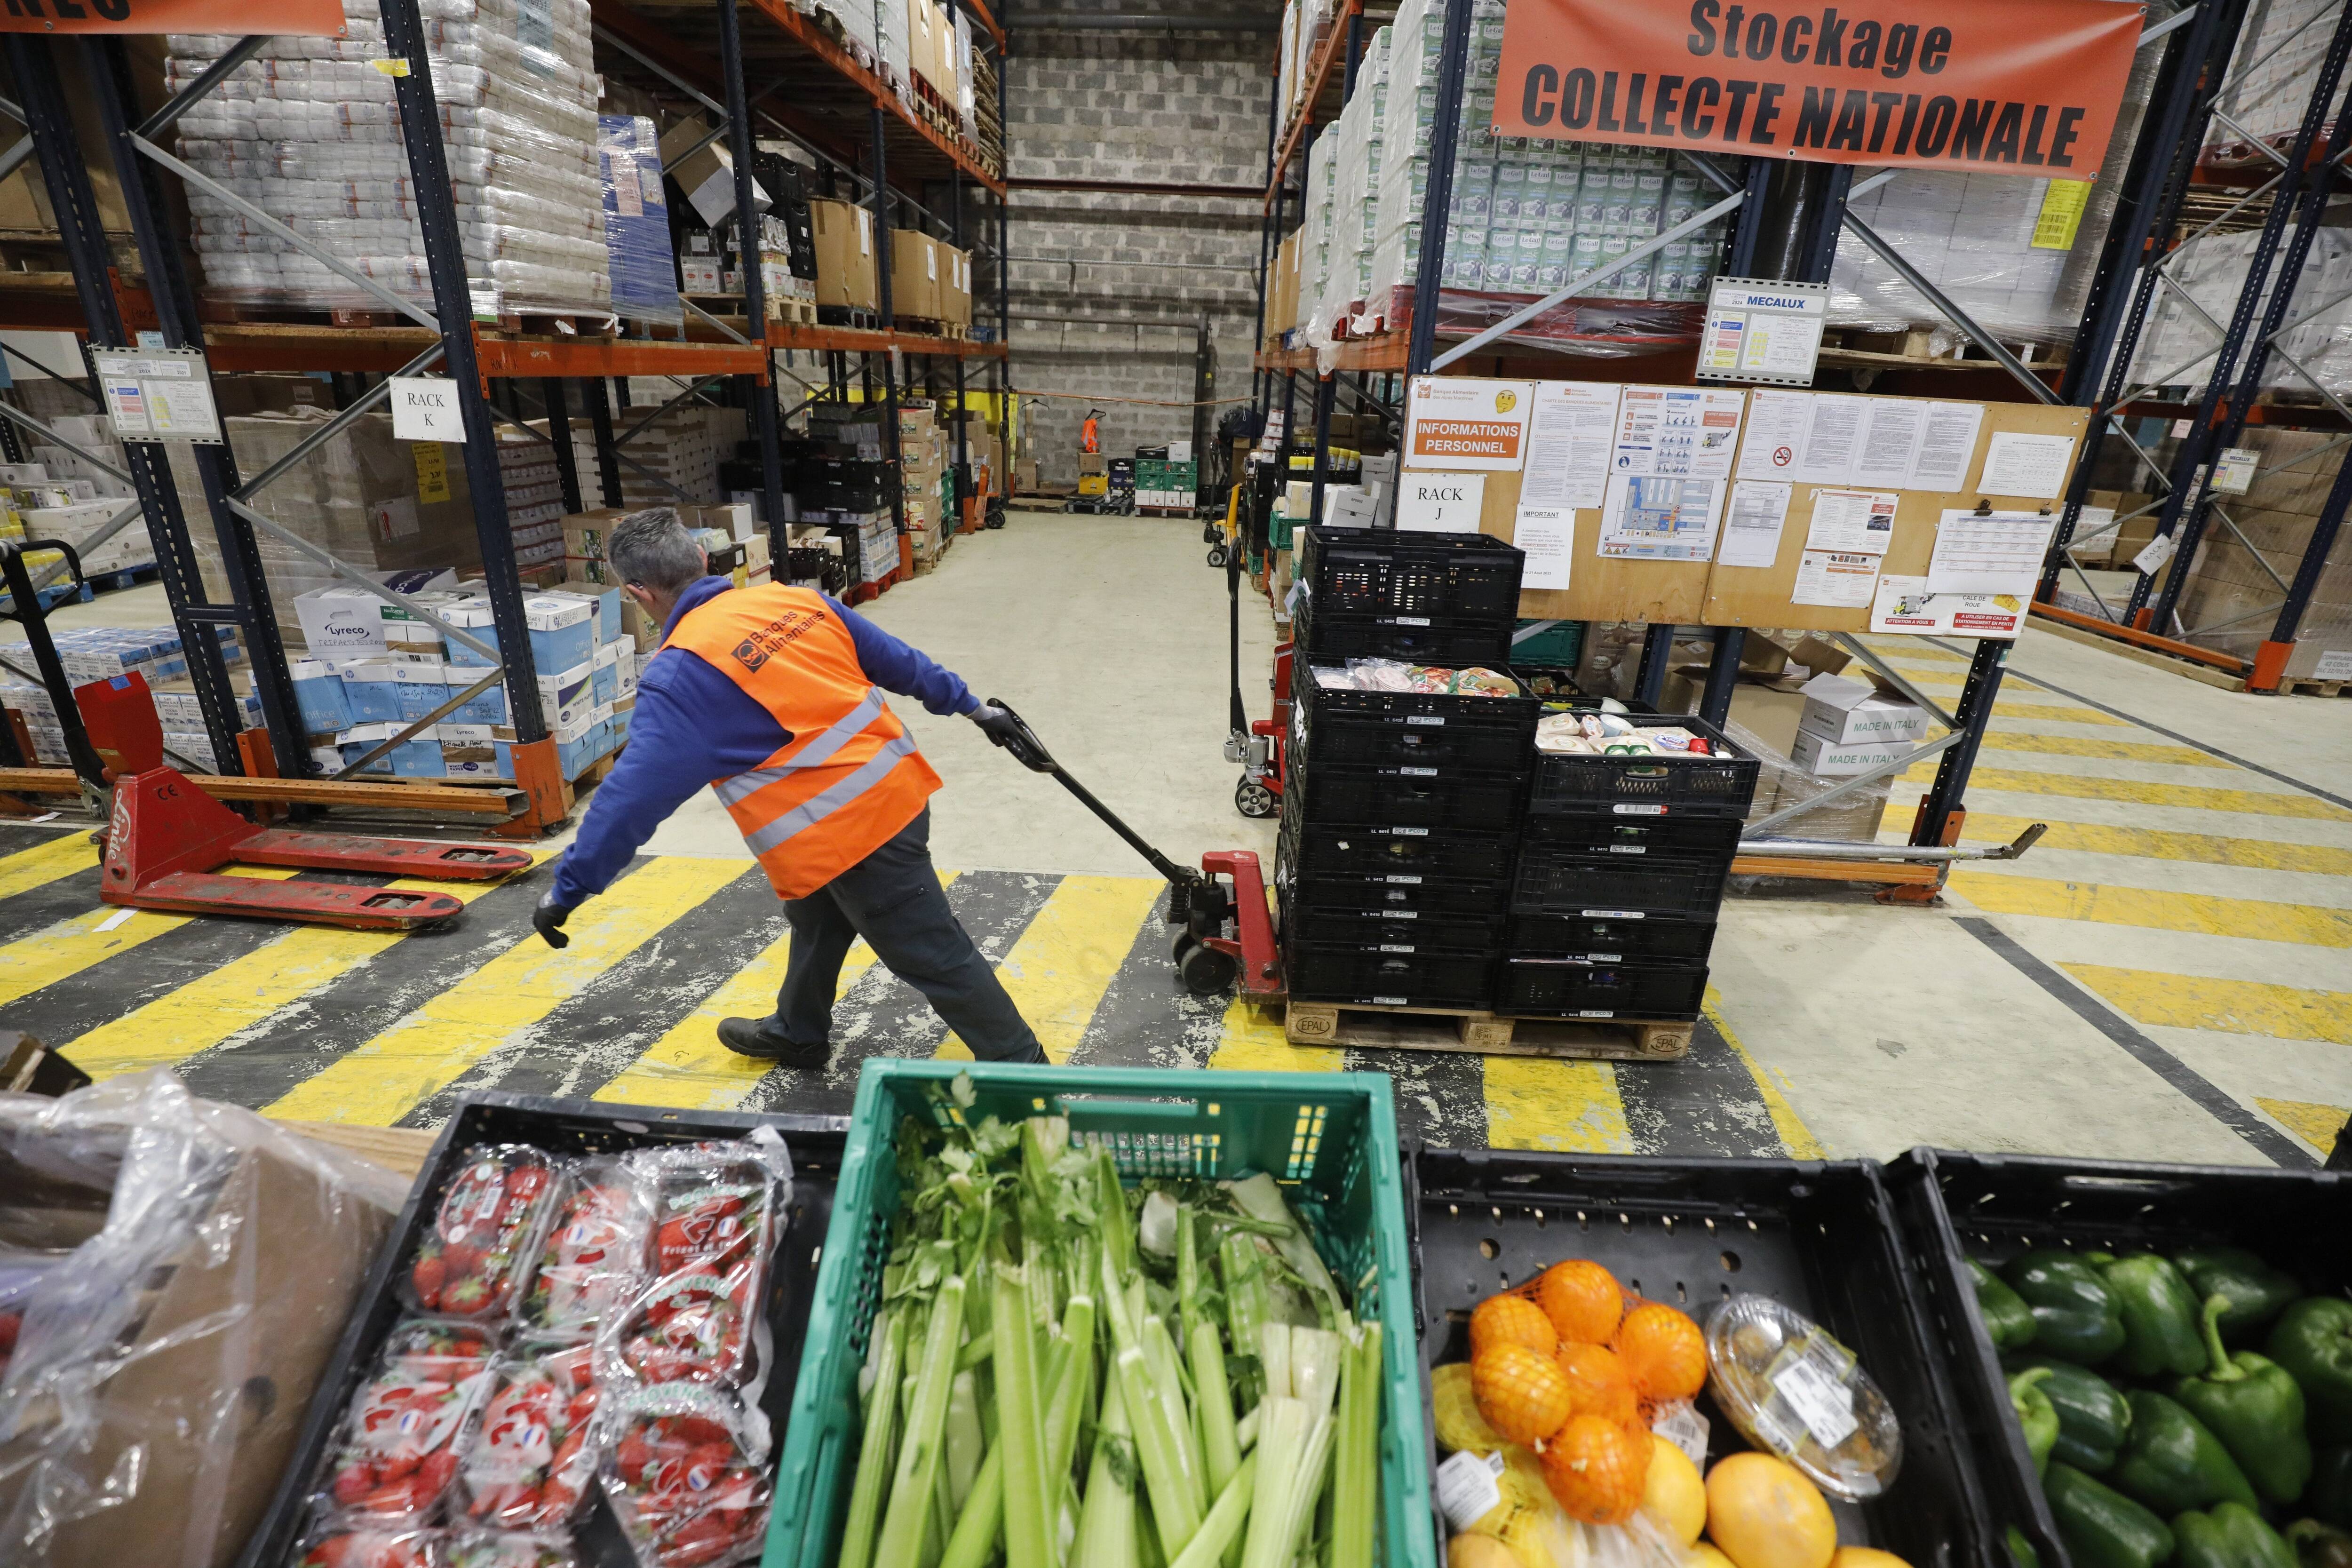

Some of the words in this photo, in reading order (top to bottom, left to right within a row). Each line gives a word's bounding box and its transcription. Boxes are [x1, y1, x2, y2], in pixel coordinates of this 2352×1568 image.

[1687, 0, 1952, 79] Stockage
[1522, 64, 1784, 145] COLLECTE
[1792, 86, 2086, 167] NATIONALE
[1747, 296, 1806, 309] MECALUX
[407, 392, 445, 407] RACK
[424, 414, 434, 426] K
[1418, 422, 1518, 437] INFORMATIONS
[1426, 439, 1507, 453] PERSONNEL
[1418, 487, 1463, 501] RACK
[1435, 508, 1442, 520] J
[2144, 544, 2164, 561] RACK
[330, 626, 364, 636] Lyreco
[750, 611, 798, 644] Banques
[765, 611, 826, 655] Alimentaires
[305, 708, 335, 720] Office
[1854, 722, 1881, 732] MADE
[1894, 719, 1919, 729] ITALY
[1828, 755, 1858, 764] MADE
[1859, 755, 1869, 764] IN
[158, 784, 178, 800] CE
[108, 788, 131, 860] Linde
[1301, 1020, 1325, 1032] EPAL
[1654, 1037, 1678, 1050] EPAL
